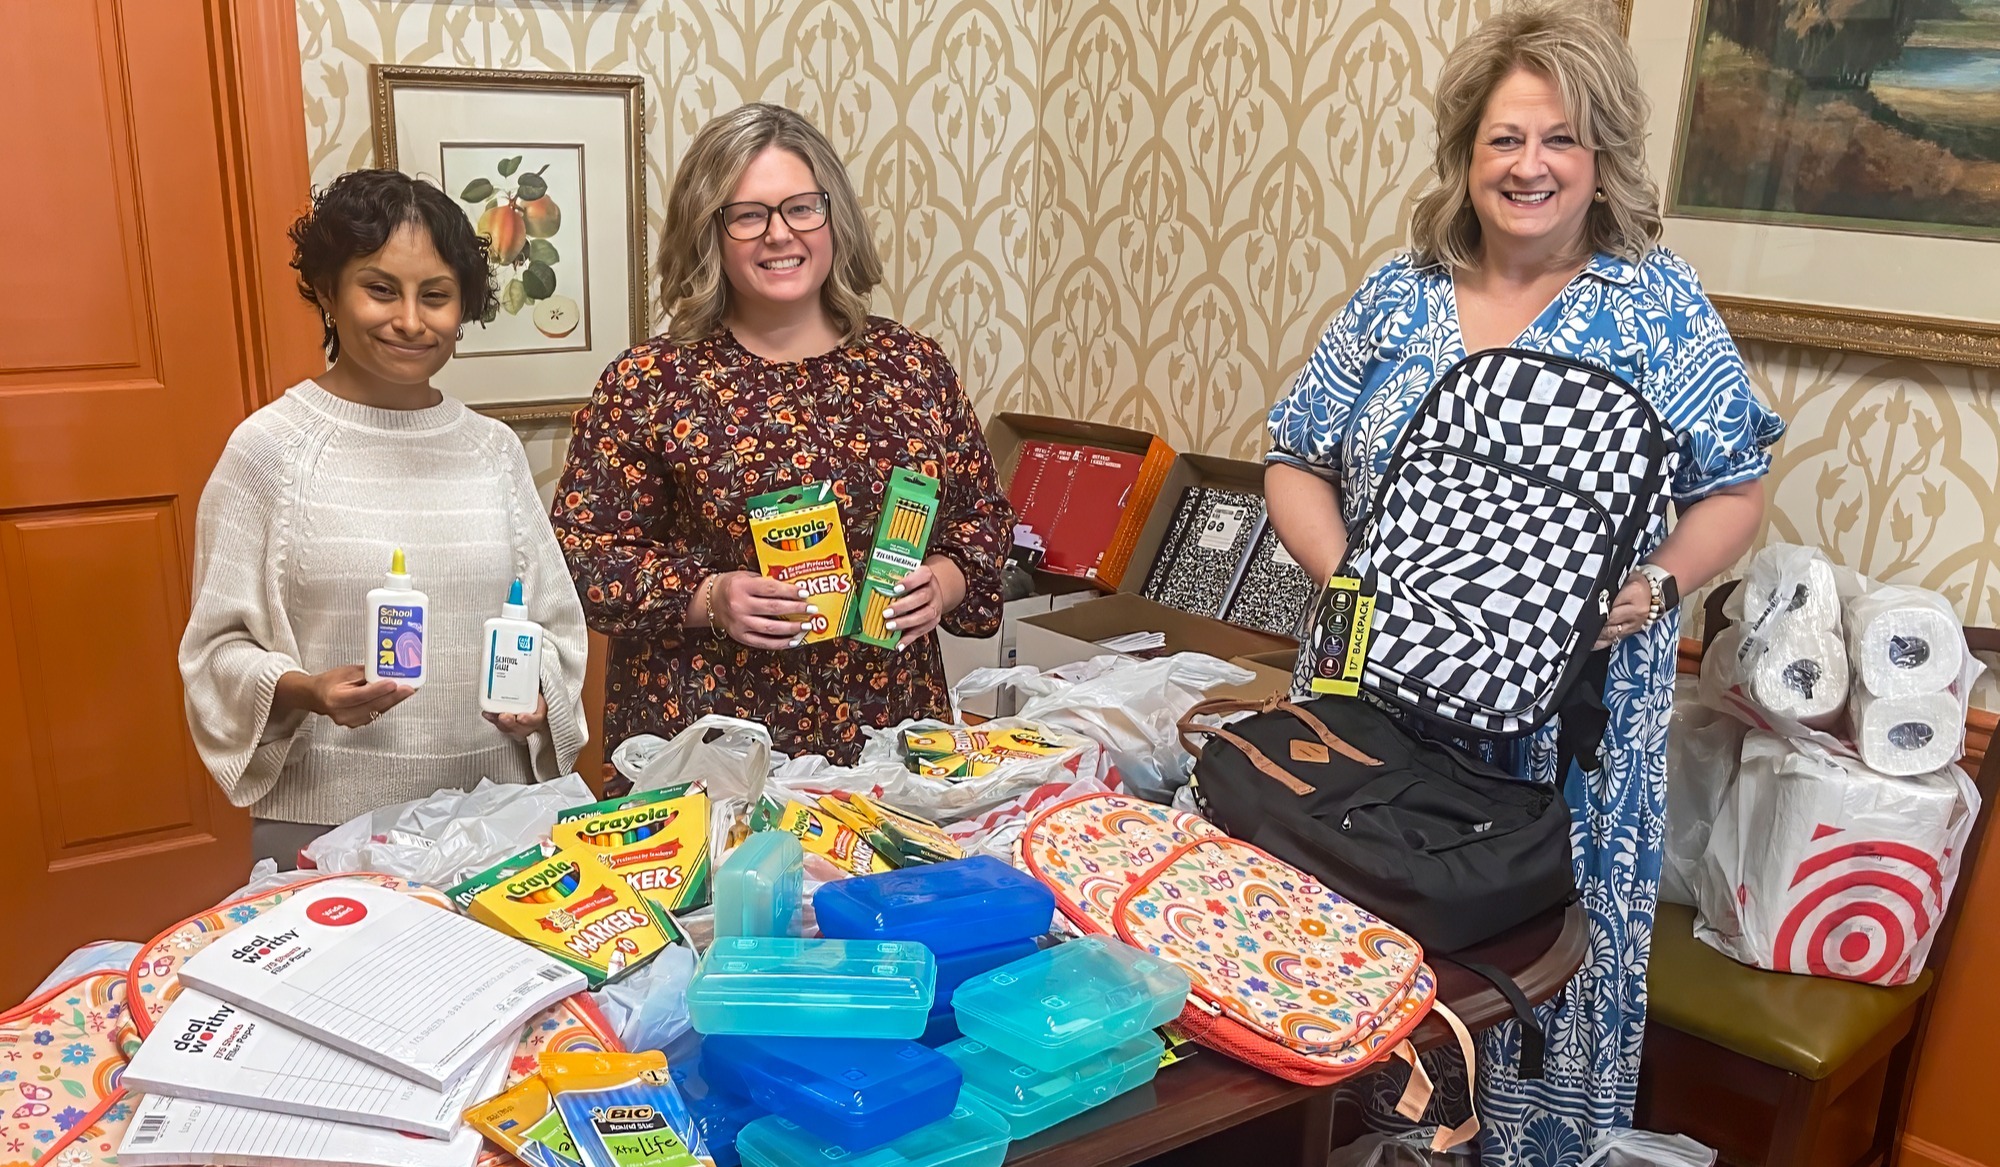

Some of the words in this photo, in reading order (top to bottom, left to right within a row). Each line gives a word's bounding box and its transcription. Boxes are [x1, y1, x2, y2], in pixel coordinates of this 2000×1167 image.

[768, 520, 826, 540] Crayola
[380, 607, 413, 618] School
[380, 616, 403, 626] Glue
[811, 616, 828, 632] 10
[1352, 600, 1370, 655] BACKPACK
[585, 808, 669, 834] Crayola
[507, 860, 572, 896] Crayola
[626, 865, 683, 892] KERS
[565, 907, 650, 958] MARKERS
[232, 935, 269, 960] deal
[243, 929, 300, 964] worthy
[617, 939, 637, 953] 10
[174, 1018, 206, 1051] deal
[189, 1004, 236, 1053] worthy
[611, 1108, 649, 1119] BIC
[609, 1123, 636, 1132] Round
